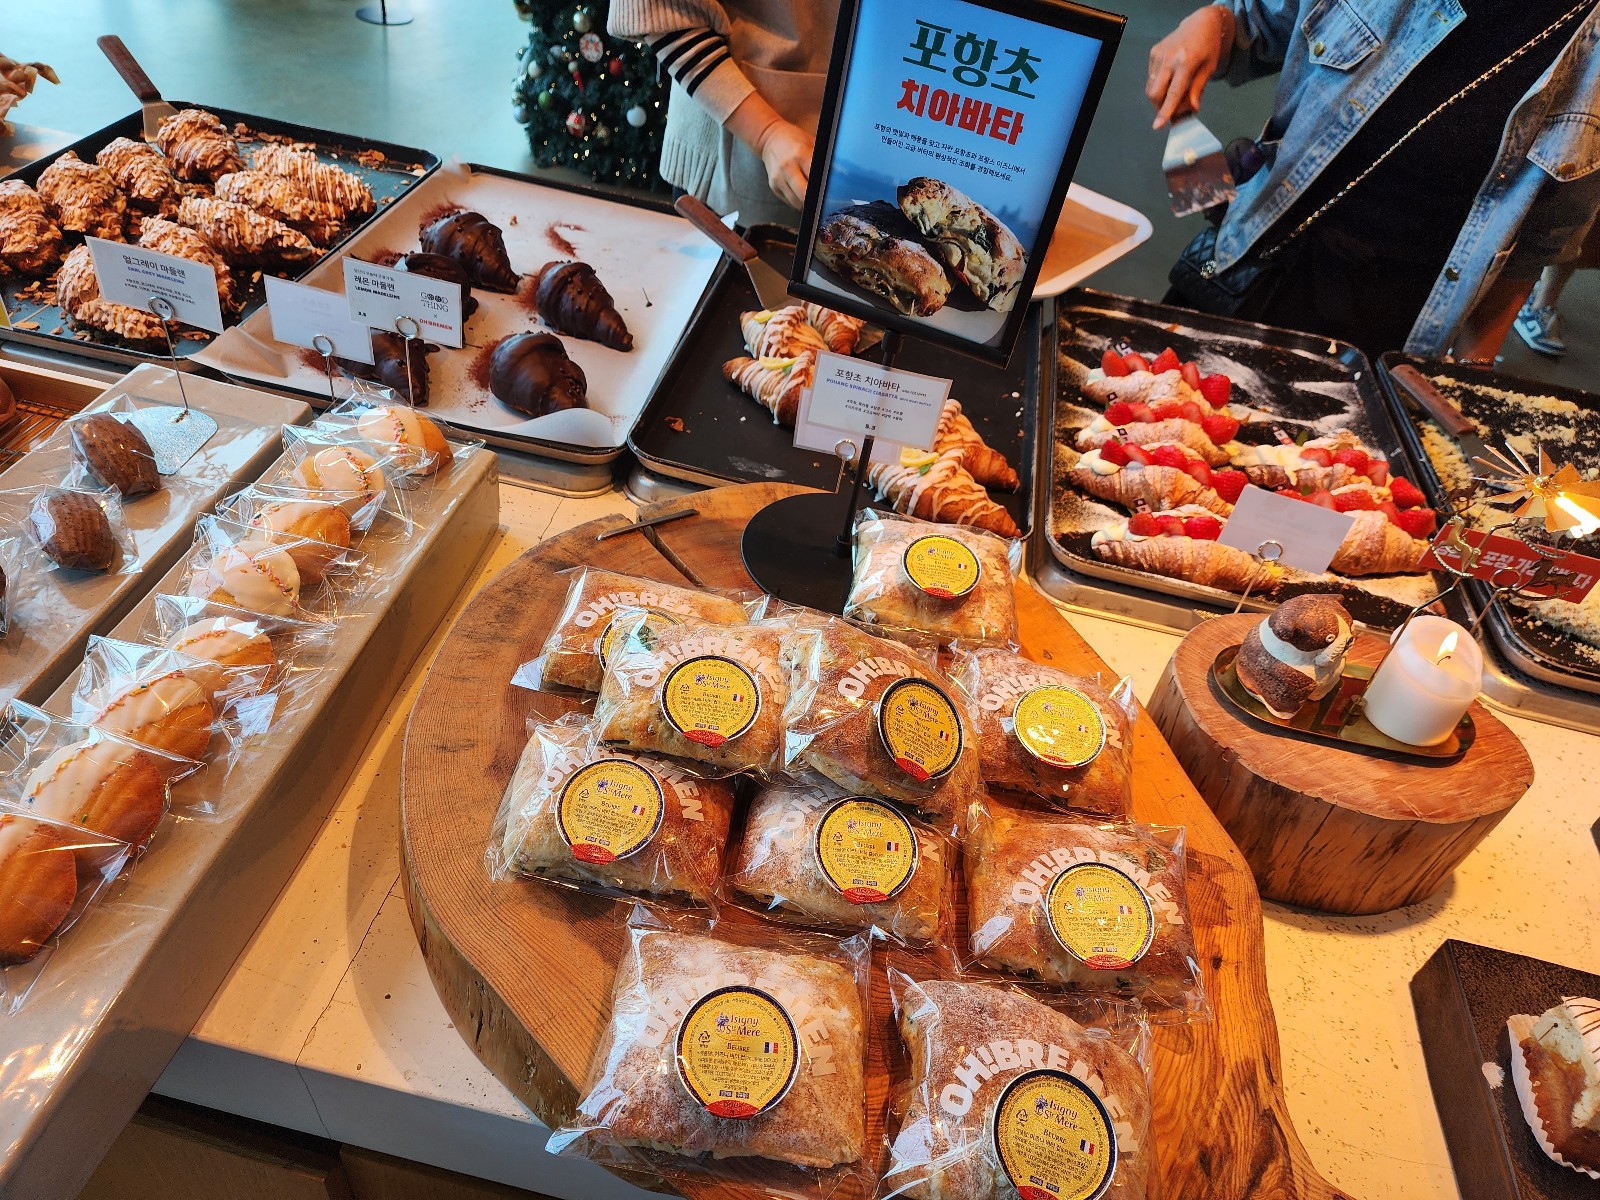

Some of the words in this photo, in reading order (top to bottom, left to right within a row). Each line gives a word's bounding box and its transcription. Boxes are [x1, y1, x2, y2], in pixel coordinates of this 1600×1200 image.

[902, 18, 1042, 100] 포항초
[896, 78, 1024, 146] 치아바타
[874, 123, 891, 134] 포항의
[954, 147, 977, 160] 포항초와
[978, 154, 995, 165] 프랑스
[997, 160, 1026, 175] 이즈니에서
[881, 135, 903, 148] 만들어진
[936, 151, 957, 165] 환상적인
[959, 160, 975, 171] 조화를
[122, 254, 159, 271] 얼그레이
[160, 264, 186, 279] 마들렌
[353, 274, 370, 287] 레몬
[371, 279, 396, 292] 마들렌
[420, 298, 449, 313] THING
[835, 368, 862, 382] 포항초
[864, 375, 901, 393] 치아바타
[1479, 550, 1515, 569] 포장
[730, 1014, 759, 1027] Isigny
[1050, 1099, 1078, 1120] Isigny
